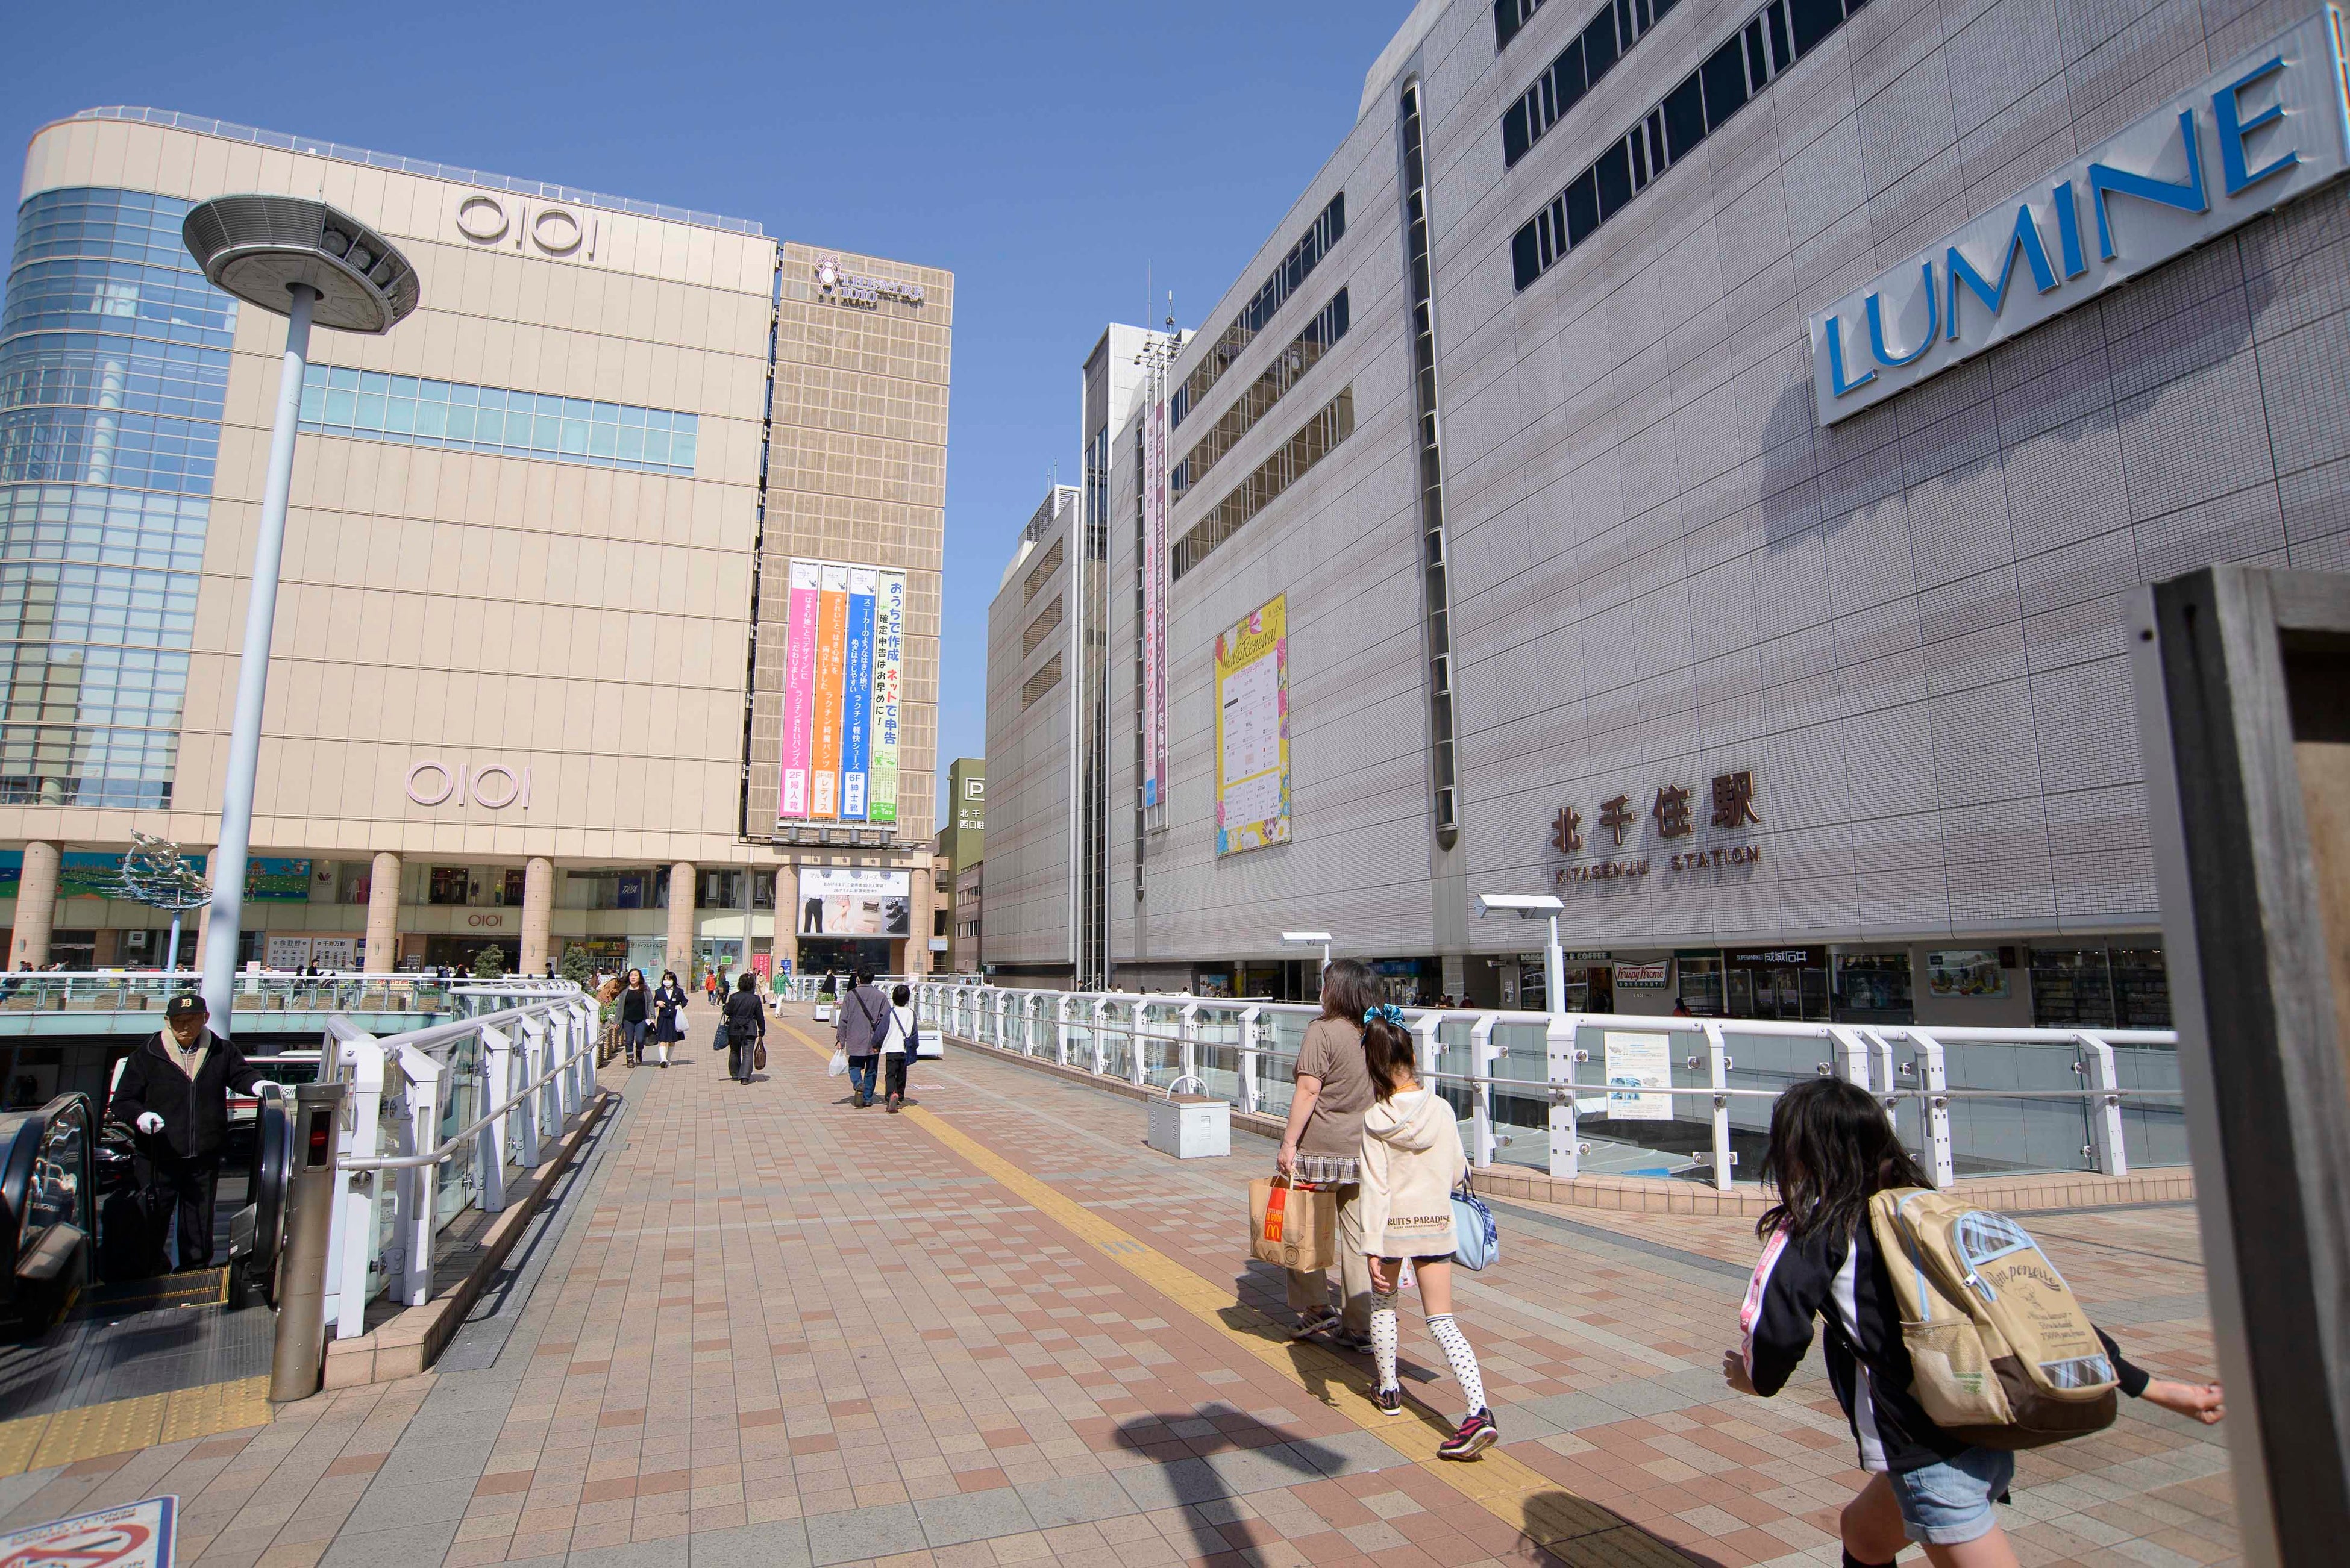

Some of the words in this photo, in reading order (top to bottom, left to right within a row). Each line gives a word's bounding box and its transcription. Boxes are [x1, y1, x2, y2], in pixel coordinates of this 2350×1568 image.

[1825, 54, 2302, 399] LUMINE
[839, 273, 925, 301] THEATRE
[841, 286, 878, 302] 1010
[887, 583, 903, 662] おうちで作成
[859, 598, 871, 692] スニーカーのようなはき心地で
[790, 637, 800, 689] こだわりました
[820, 646, 830, 690] 両立しました
[850, 639, 859, 693] ぬぎはきしやすい
[884, 669, 898, 745] ネットで申告
[792, 690, 803, 767] ラクチンきれいパンプス
[789, 781, 799, 810] 婦人靴
[819, 779, 830, 810] レディス
[850, 784, 859, 812] 紳士靴
[970, 782, 985, 796] P
[960, 808, 985, 819] 北千
[1551, 771, 1761, 852] 北千住駅
[1555, 858, 1649, 884] KITASENJU
[1670, 845, 1761, 870] STATION
[622, 884, 638, 894] TAYA
[1764, 951, 1806, 963] 成城石井
[1617, 966, 1640, 981] Krispy
[1640, 966, 1664, 979] Kreme
[181, 998, 192, 1007] D
[1387, 1217, 1411, 1226] RUITS
[1414, 1215, 1451, 1224] PARADISE
